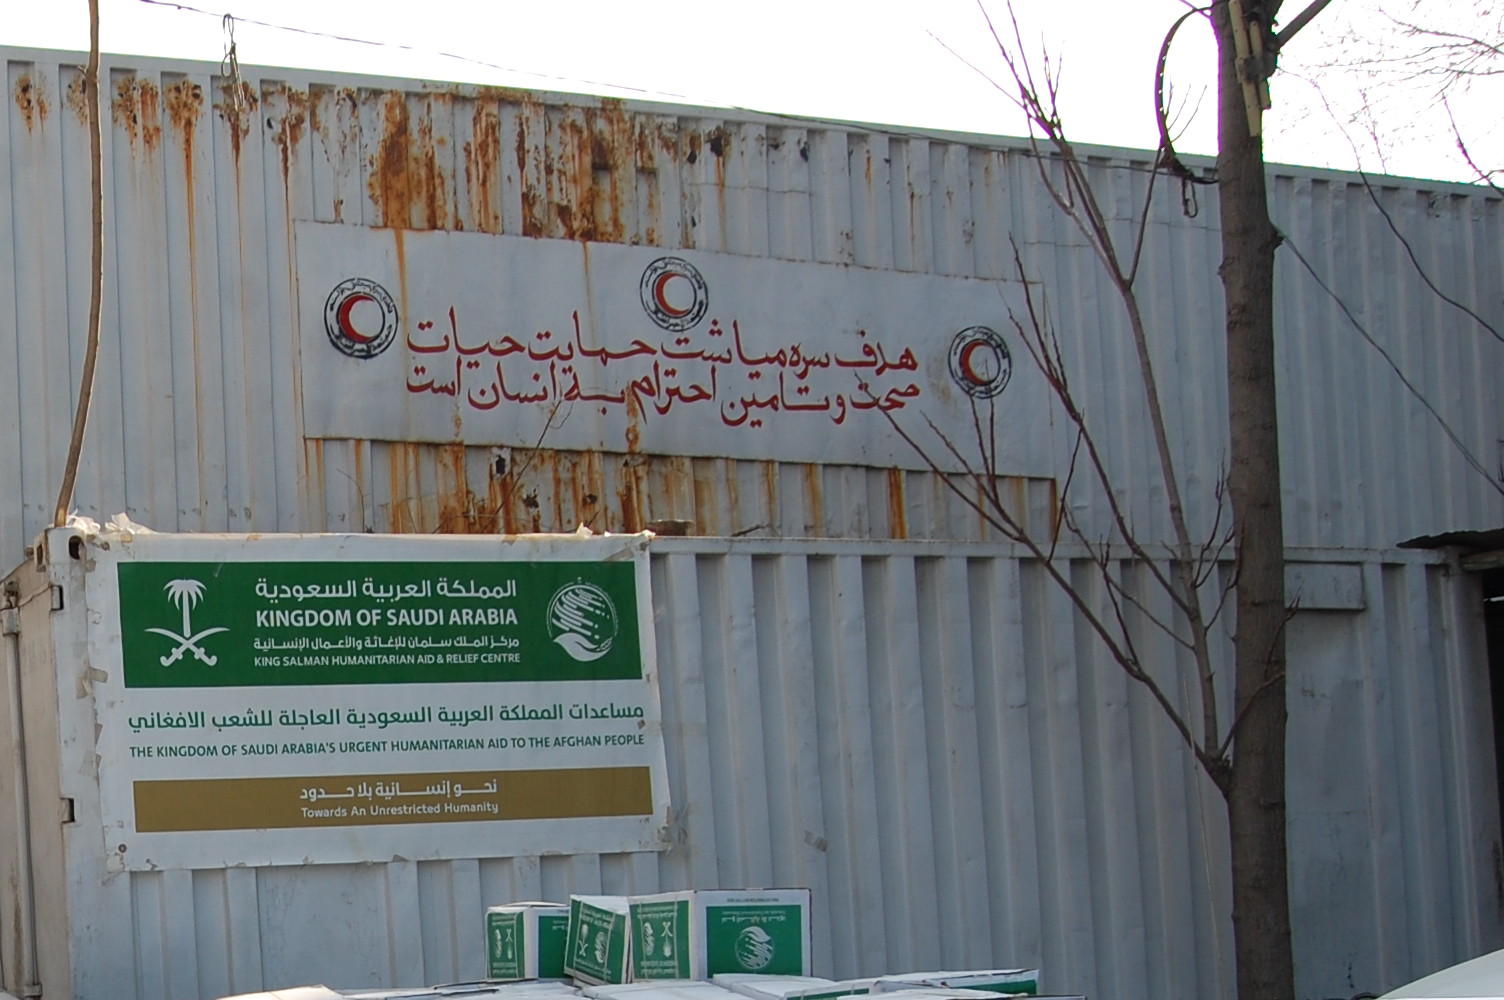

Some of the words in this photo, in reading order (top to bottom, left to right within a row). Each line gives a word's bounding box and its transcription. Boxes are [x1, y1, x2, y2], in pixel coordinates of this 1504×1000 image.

[788, 341, 830, 380] سره
[834, 328, 918, 376] هدف
[406, 354, 462, 398] است
[467, 359, 556, 411] انسان
[631, 358, 716, 426] احترام
[849, 381, 920, 412] صحت
[254, 576, 357, 604] السعودية
[360, 576, 432, 604] العربية
[435, 576, 517, 600] المملكة
[255, 608, 353, 628] KINGDOM
[355, 608, 382, 627] OF
[385, 607, 445, 627] SAUDI
[447, 607, 519, 626] ARABIA
[252, 635, 310, 652] الإنسانية
[309, 634, 363, 651] والأعمال
[363, 634, 407, 651] للإغاثة
[406, 635, 453, 650] سلمان
[452, 634, 489, 649] الملك
[488, 634, 521, 649] مركز
[253, 655, 281, 668] KING
[281, 654, 330, 667] SALMAN
[330, 653, 416, 666] HUMANITARIAN
[415, 653, 436, 665] AID
[435, 653, 445, 665] &
[444, 652, 480, 664] RELIEF
[479, 651, 521, 664] CENTRE
[127, 710, 206, 734] الافغاني
[210, 707, 273, 733] للشعب
[277, 707, 341, 731] العاجلة
[345, 705, 433, 730] السعودية
[436, 704, 494, 728] العربية
[498, 702, 564, 722] المملكة
[568, 701, 646, 721] مساعدات
[128, 745, 154, 759] THE
[155, 744, 219, 758] KINGDOM
[220, 743, 238, 757] OF
[239, 742, 279, 757] SAUDI
[280, 741, 337, 755] ARABIA'S
[338, 739, 389, 754] URGENT
[389, 737, 485, 753] HUMANITARIAN
[486, 736, 509, 750] AID
[509, 736, 527, 749] TO
[526, 735, 551, 749] THE
[552, 734, 602, 748] AFGHAN
[603, 733, 645, 747] PEOPLE
[298, 785, 355, 803] حدود
[356, 780, 373, 802] بلا
[374, 779, 451, 801] إنسانية
[452, 777, 498, 798] نحو
[299, 805, 348, 819] Towards
[349, 804, 367, 817] An
[369, 801, 441, 816] Unrestricted
[443, 800, 499, 815] Humanity
